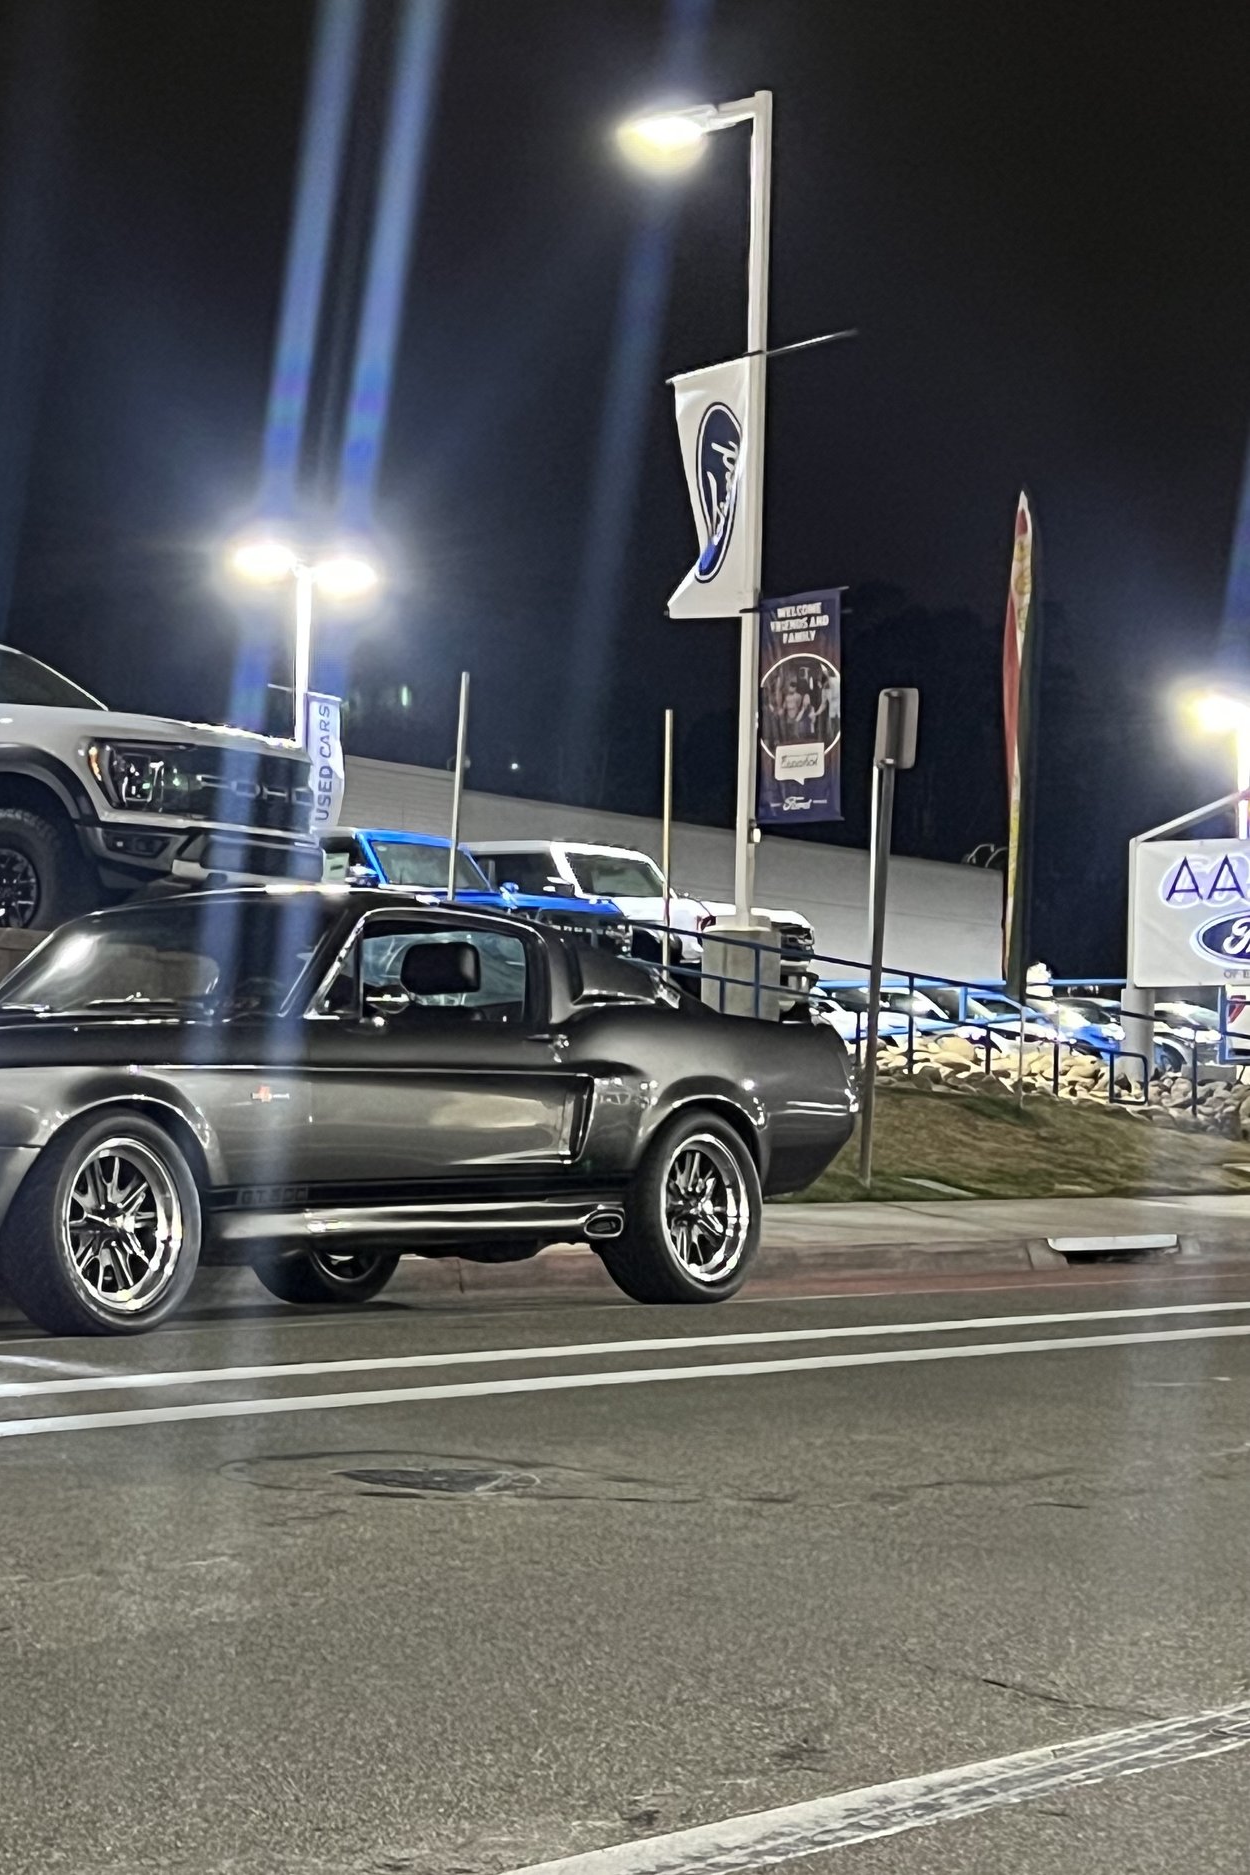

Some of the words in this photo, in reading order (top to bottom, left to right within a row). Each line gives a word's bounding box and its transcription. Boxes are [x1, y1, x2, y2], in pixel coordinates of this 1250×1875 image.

[777, 601, 822, 618] WELCOME
[770, 616, 808, 632] FRIENDS
[809, 614, 829, 628] AND
[782, 629, 816, 644] FAMILY
[318, 704, 332, 759] CARS
[314, 765, 333, 821] USED
[782, 796, 813, 811] Ford
